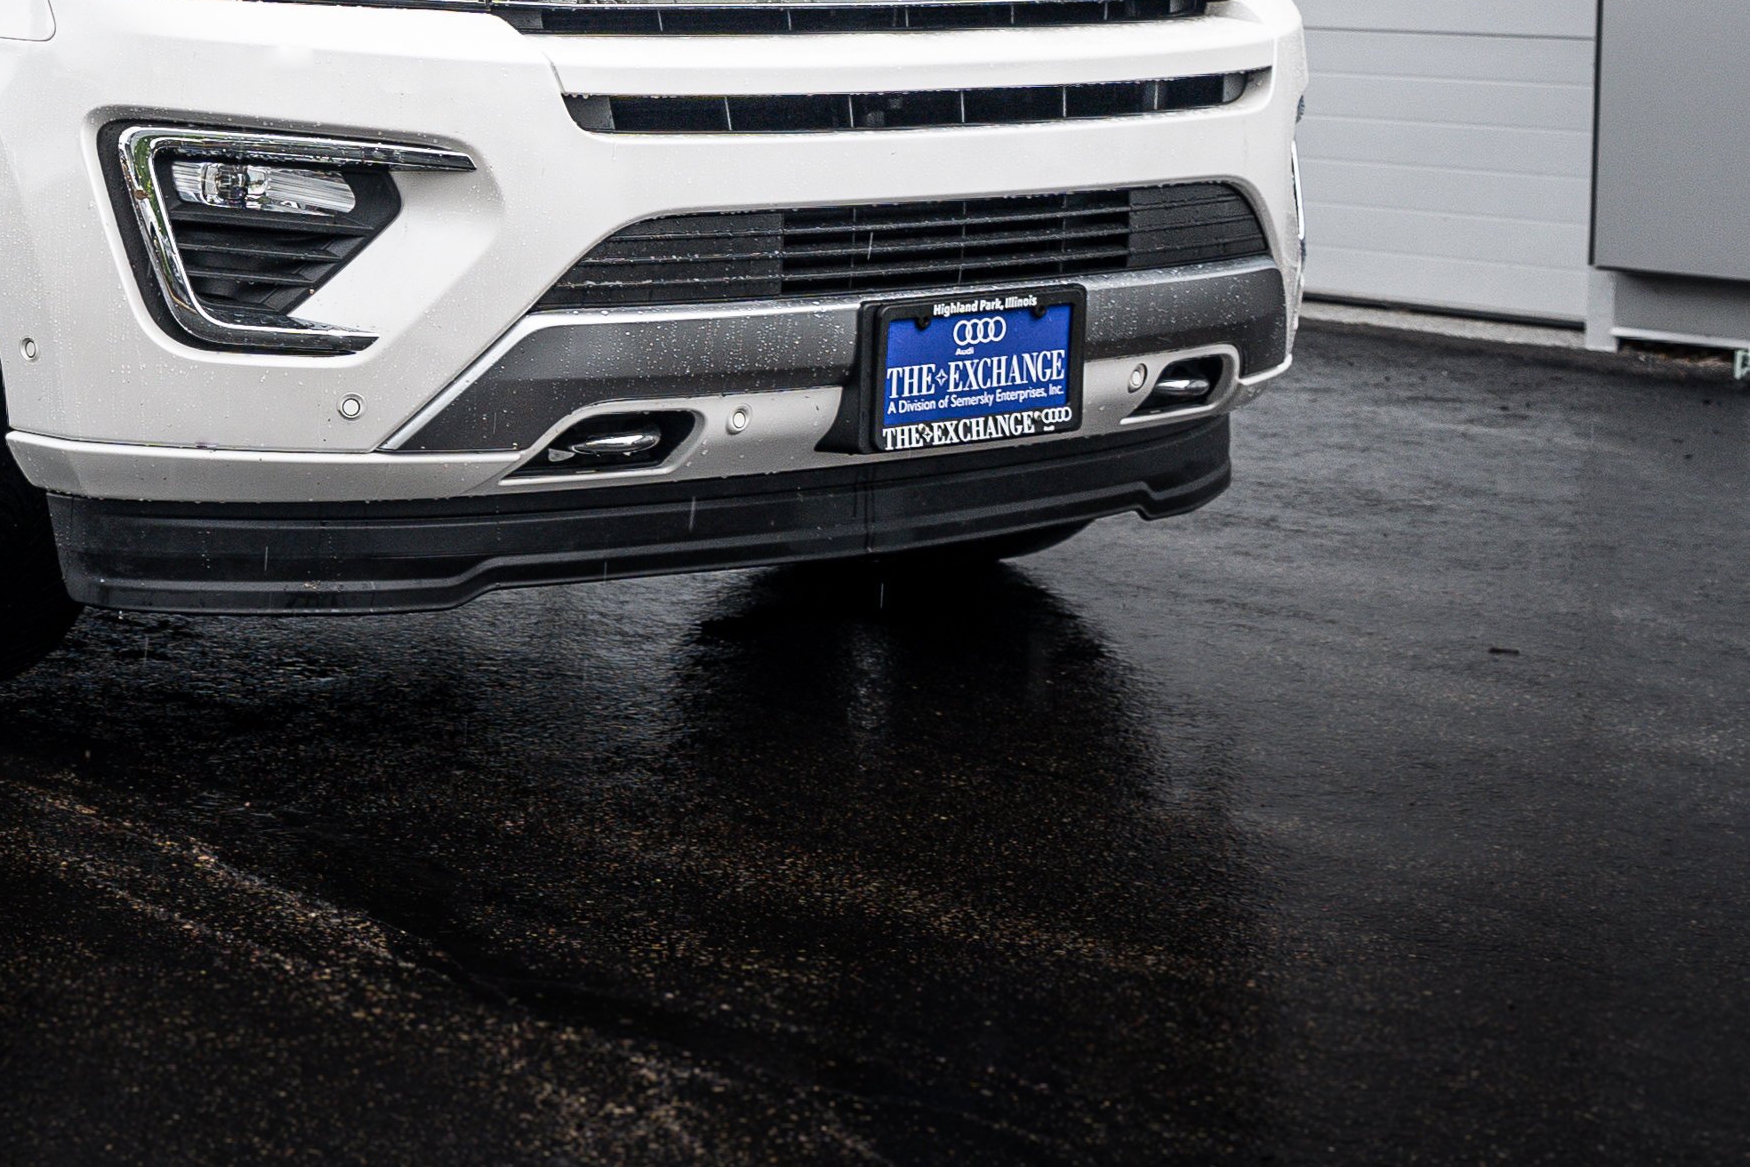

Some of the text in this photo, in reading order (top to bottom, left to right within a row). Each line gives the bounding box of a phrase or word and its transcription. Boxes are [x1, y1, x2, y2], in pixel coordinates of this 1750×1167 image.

[933, 295, 1037, 317] Highland Park, Illinois
[887, 350, 1065, 399] THE EXCHANGE
[887, 383, 1064, 414] A Division of Semersky Enterprises, Inc.
[882, 411, 1035, 451] THE EXCHANGE
